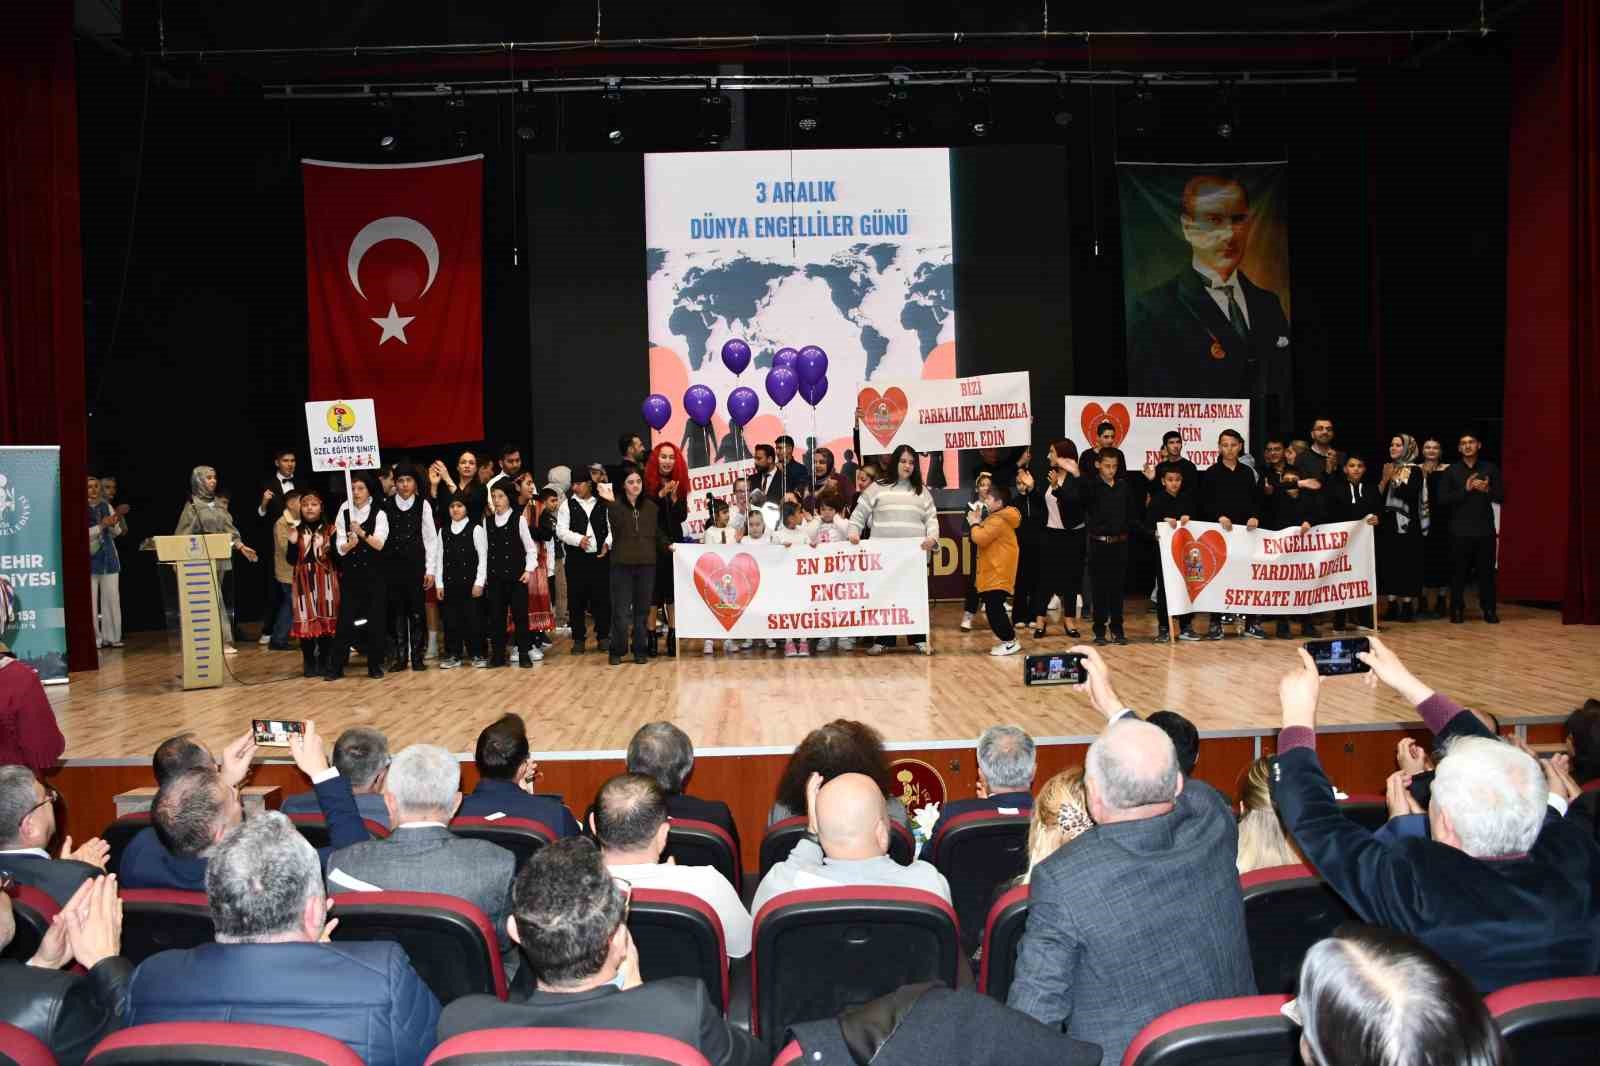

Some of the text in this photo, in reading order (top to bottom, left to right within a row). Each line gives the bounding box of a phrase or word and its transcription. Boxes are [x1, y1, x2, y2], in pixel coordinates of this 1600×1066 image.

[756, 181, 836, 203] 3 ARALIK
[690, 209, 909, 239] DÜNYA ENGELLİLER GÜNÜ
[961, 379, 982, 396] BİZİ
[919, 402, 1028, 424] FARKLILIKLARIMIZLA
[1136, 402, 1175, 418] HAYATI
[944, 426, 1006, 448] KABUL EDİN
[1187, 450, 1219, 466] YOKT
[1264, 529, 1349, 554] ENGELLİLER
[0, 553, 43, 569] EHİR
[796, 550, 883, 576] EN BÜYÜK
[1251, 562, 1315, 580] YARDIMA
[811, 581, 870, 602] ENGEL
[1225, 588, 1290, 609] ŞEFKATE
[768, 604, 915, 630] SEVGİSİZLİKTİR.
